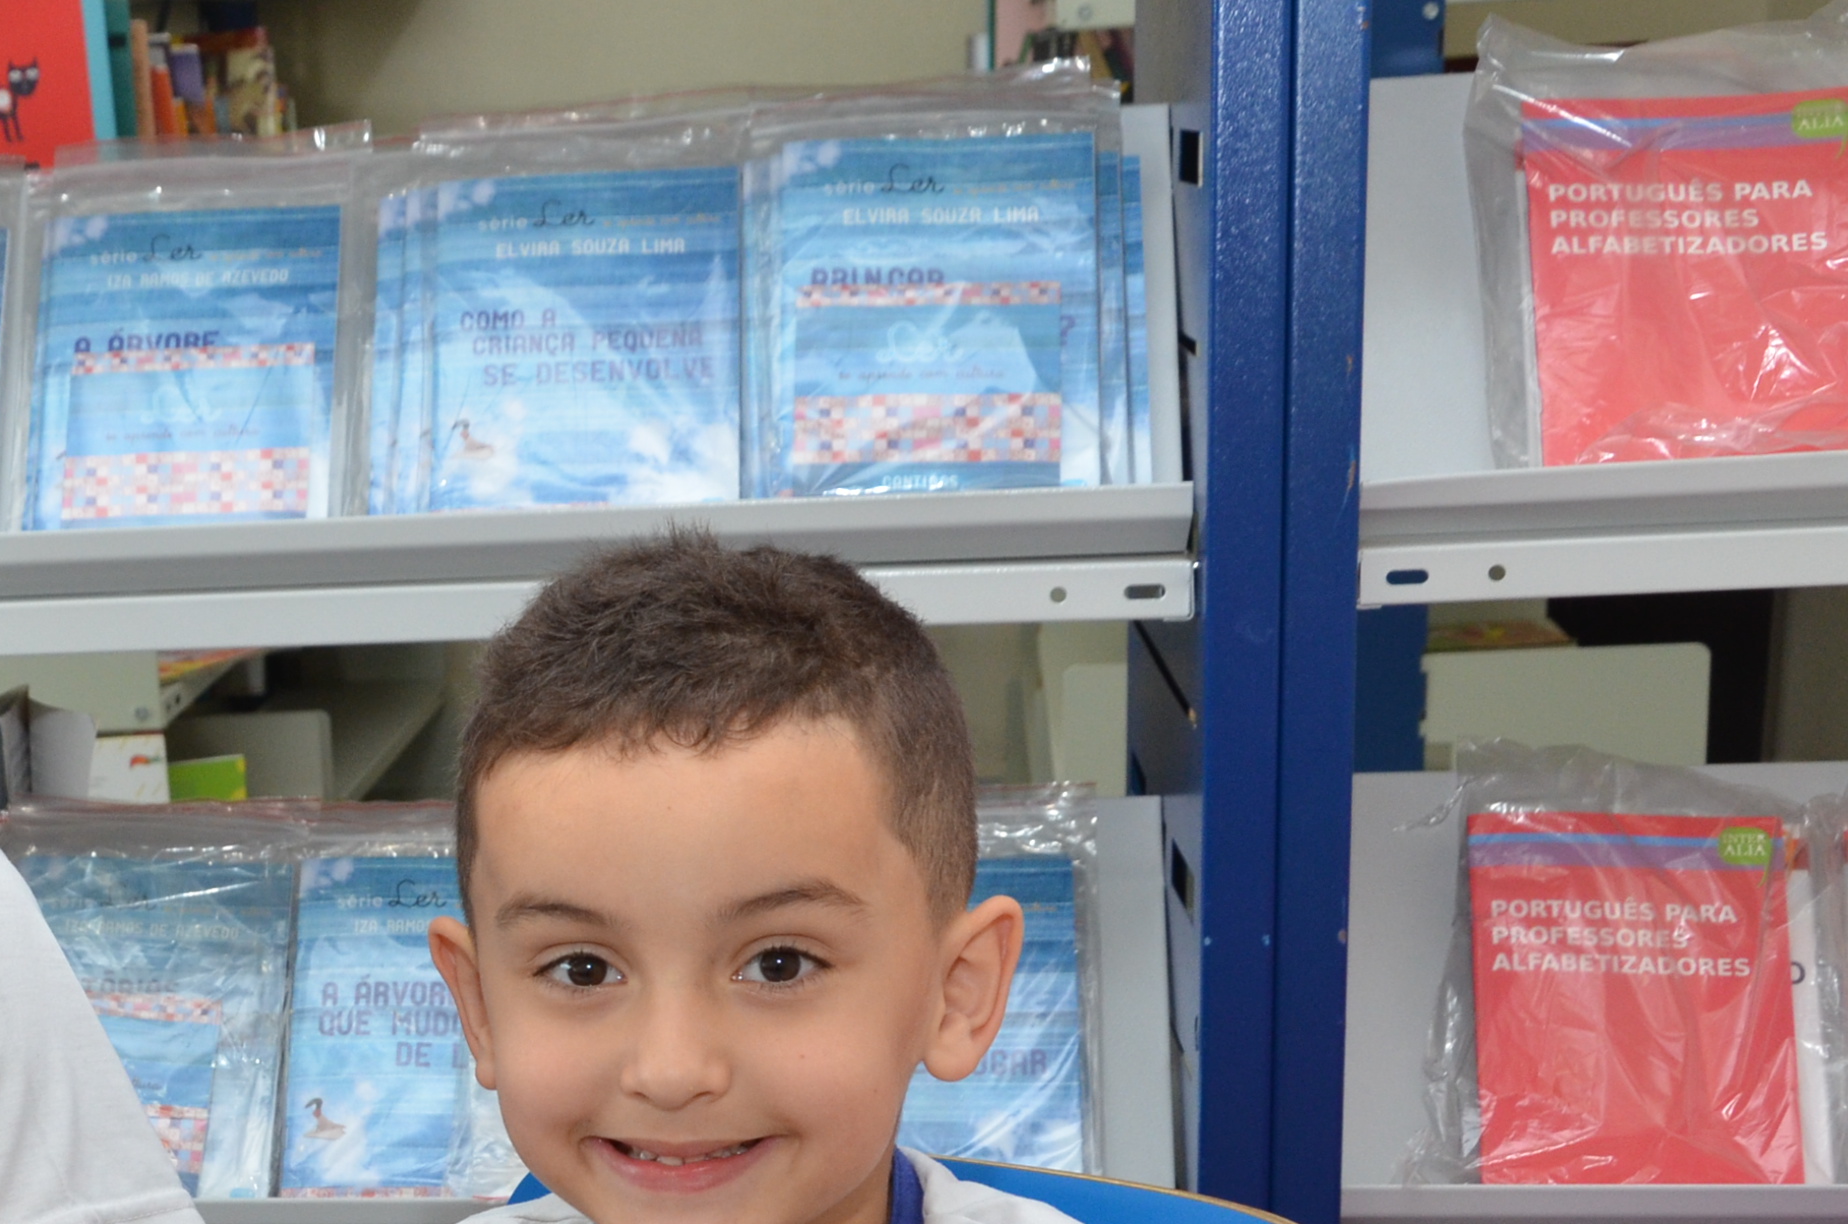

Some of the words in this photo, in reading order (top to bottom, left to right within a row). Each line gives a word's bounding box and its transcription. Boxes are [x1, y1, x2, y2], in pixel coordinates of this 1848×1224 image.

[880, 163, 945, 194] Ler
[1548, 178, 1722, 203] PORTUGUÊS
[1735, 179, 1813, 201] PARA
[532, 200, 595, 228] Ler
[842, 207, 909, 225] ELVIRA
[921, 206, 981, 224] SOUZA
[993, 206, 1039, 223] LIMA
[1550, 209, 1760, 229] PROFESSORES
[142, 234, 202, 263] Ler
[496, 241, 560, 259] ELVIRA
[571, 238, 630, 256] SOUZA
[641, 237, 686, 254] LIMA
[1551, 232, 1828, 255] ALFABETIZADORES
[222, 268, 290, 285] AZEVEDO
[460, 309, 525, 332] COMO
[542, 308, 557, 328] A
[473, 332, 575, 357] CRIANÇA
[592, 323, 702, 352] PEQUENA
[484, 363, 517, 387] SE
[536, 356, 715, 386] DESENVOLVE
[1724, 843, 1766, 857] ALIA
[388, 879, 447, 908] Ler
[1490, 896, 1656, 922] PORTUGUÊS
[1665, 904, 1738, 923] PARA
[354, 919, 378, 933] IZA
[1491, 925, 1690, 949] PROFESSORES
[1492, 952, 1752, 977] ALFABETIZADORES
[321, 981, 339, 1007] A
[354, 973, 454, 1010] ÁRVOR
[319, 1010, 372, 1037] QUE
[396, 1041, 433, 1067] DE
